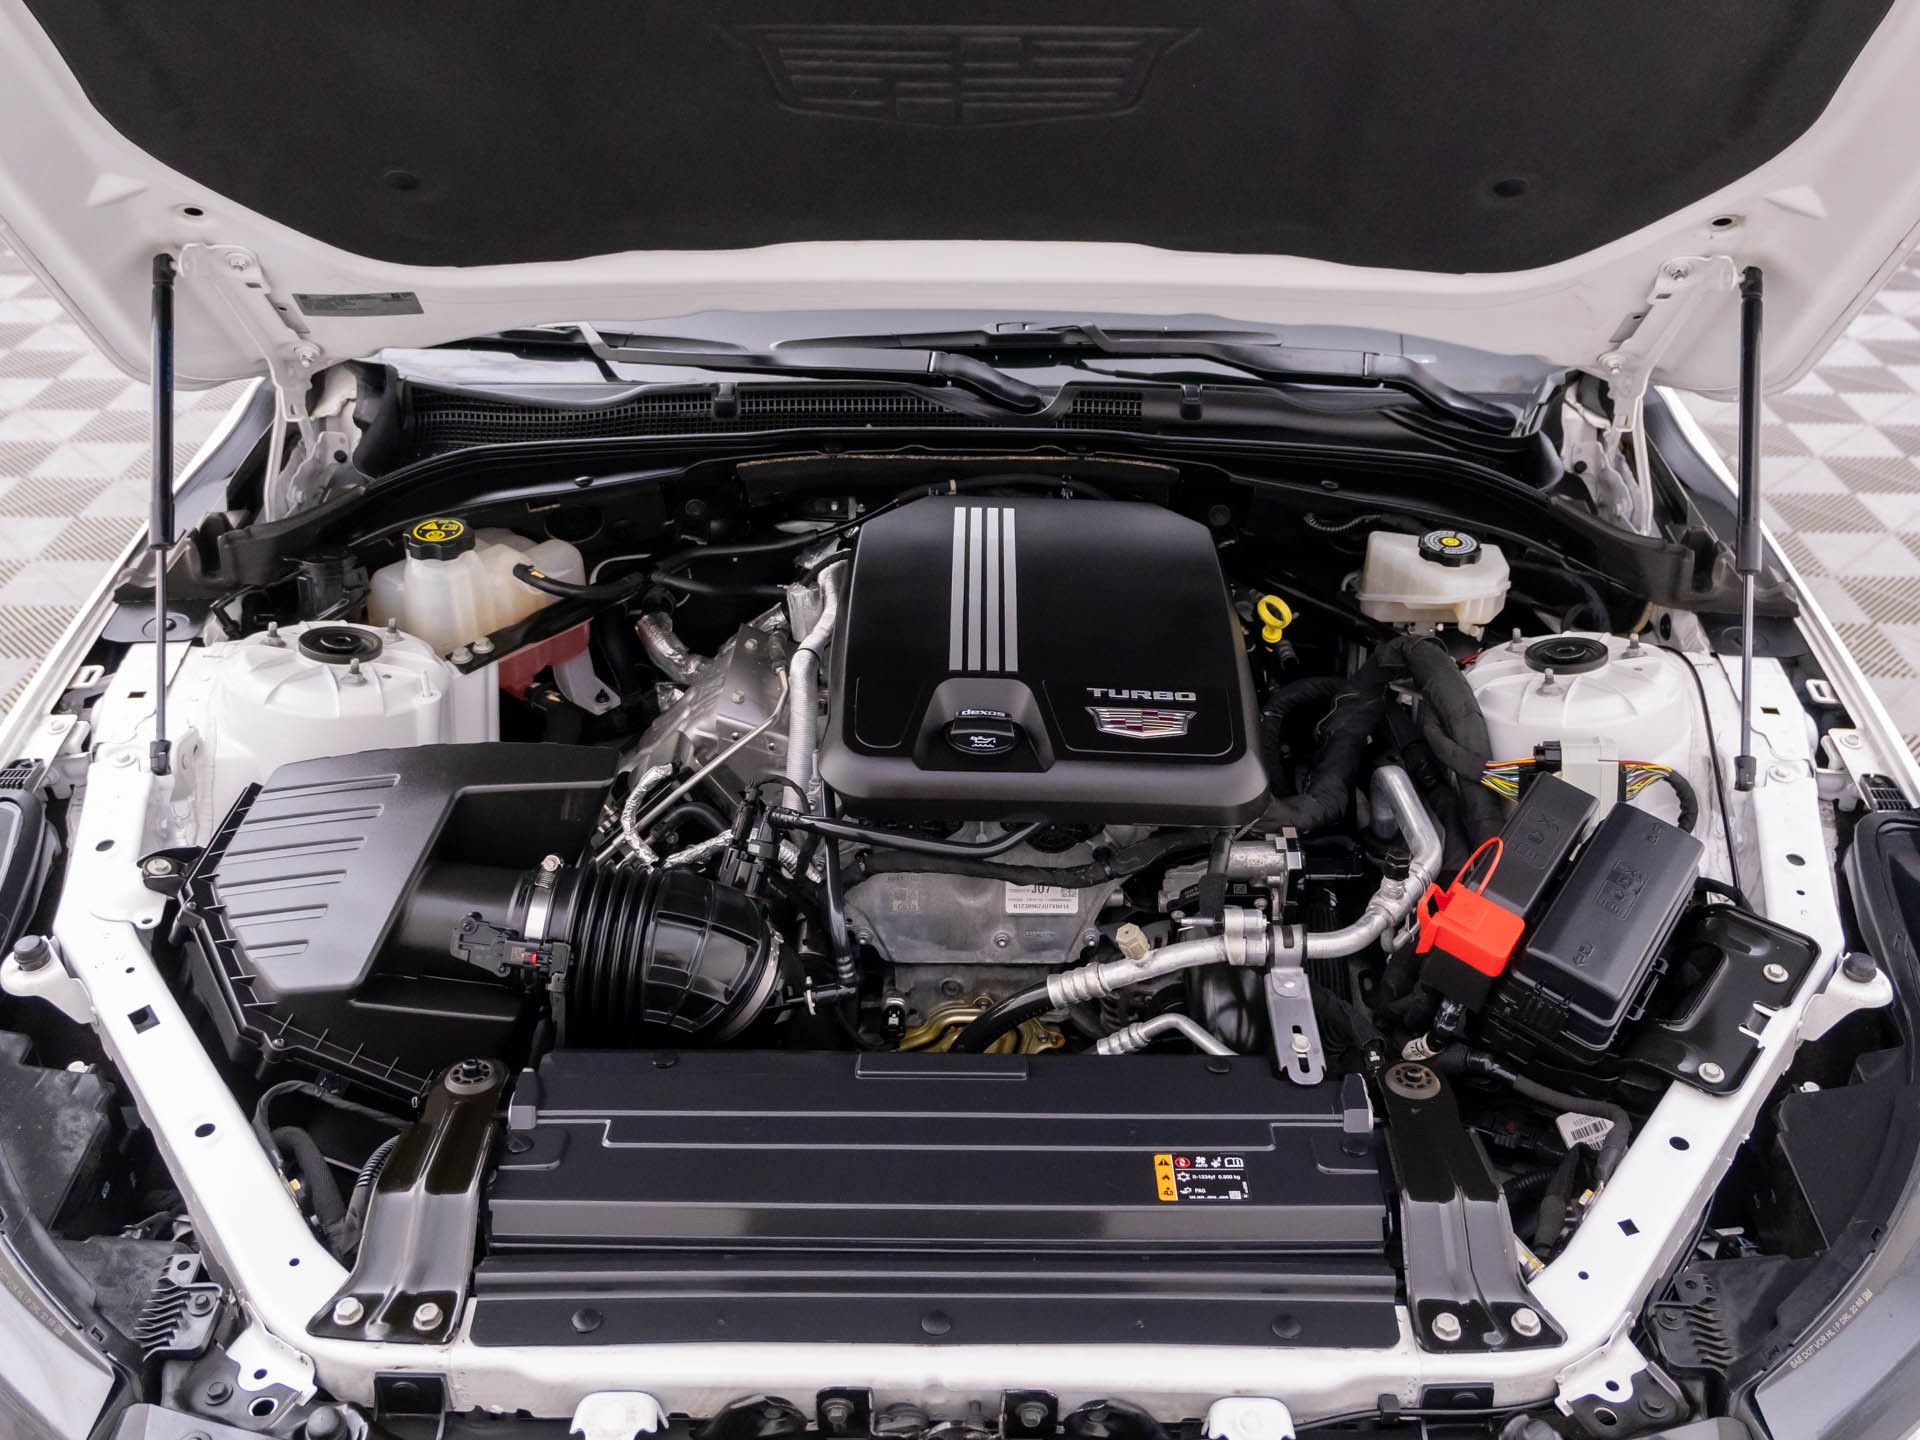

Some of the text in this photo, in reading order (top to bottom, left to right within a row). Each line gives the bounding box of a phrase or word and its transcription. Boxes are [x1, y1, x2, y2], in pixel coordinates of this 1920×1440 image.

[1086, 687, 1197, 701] TURBO
[961, 709, 1006, 717] dexos
[1801, 1345, 1816, 1360] DOT
[1813, 1335, 1828, 1349] VOR
